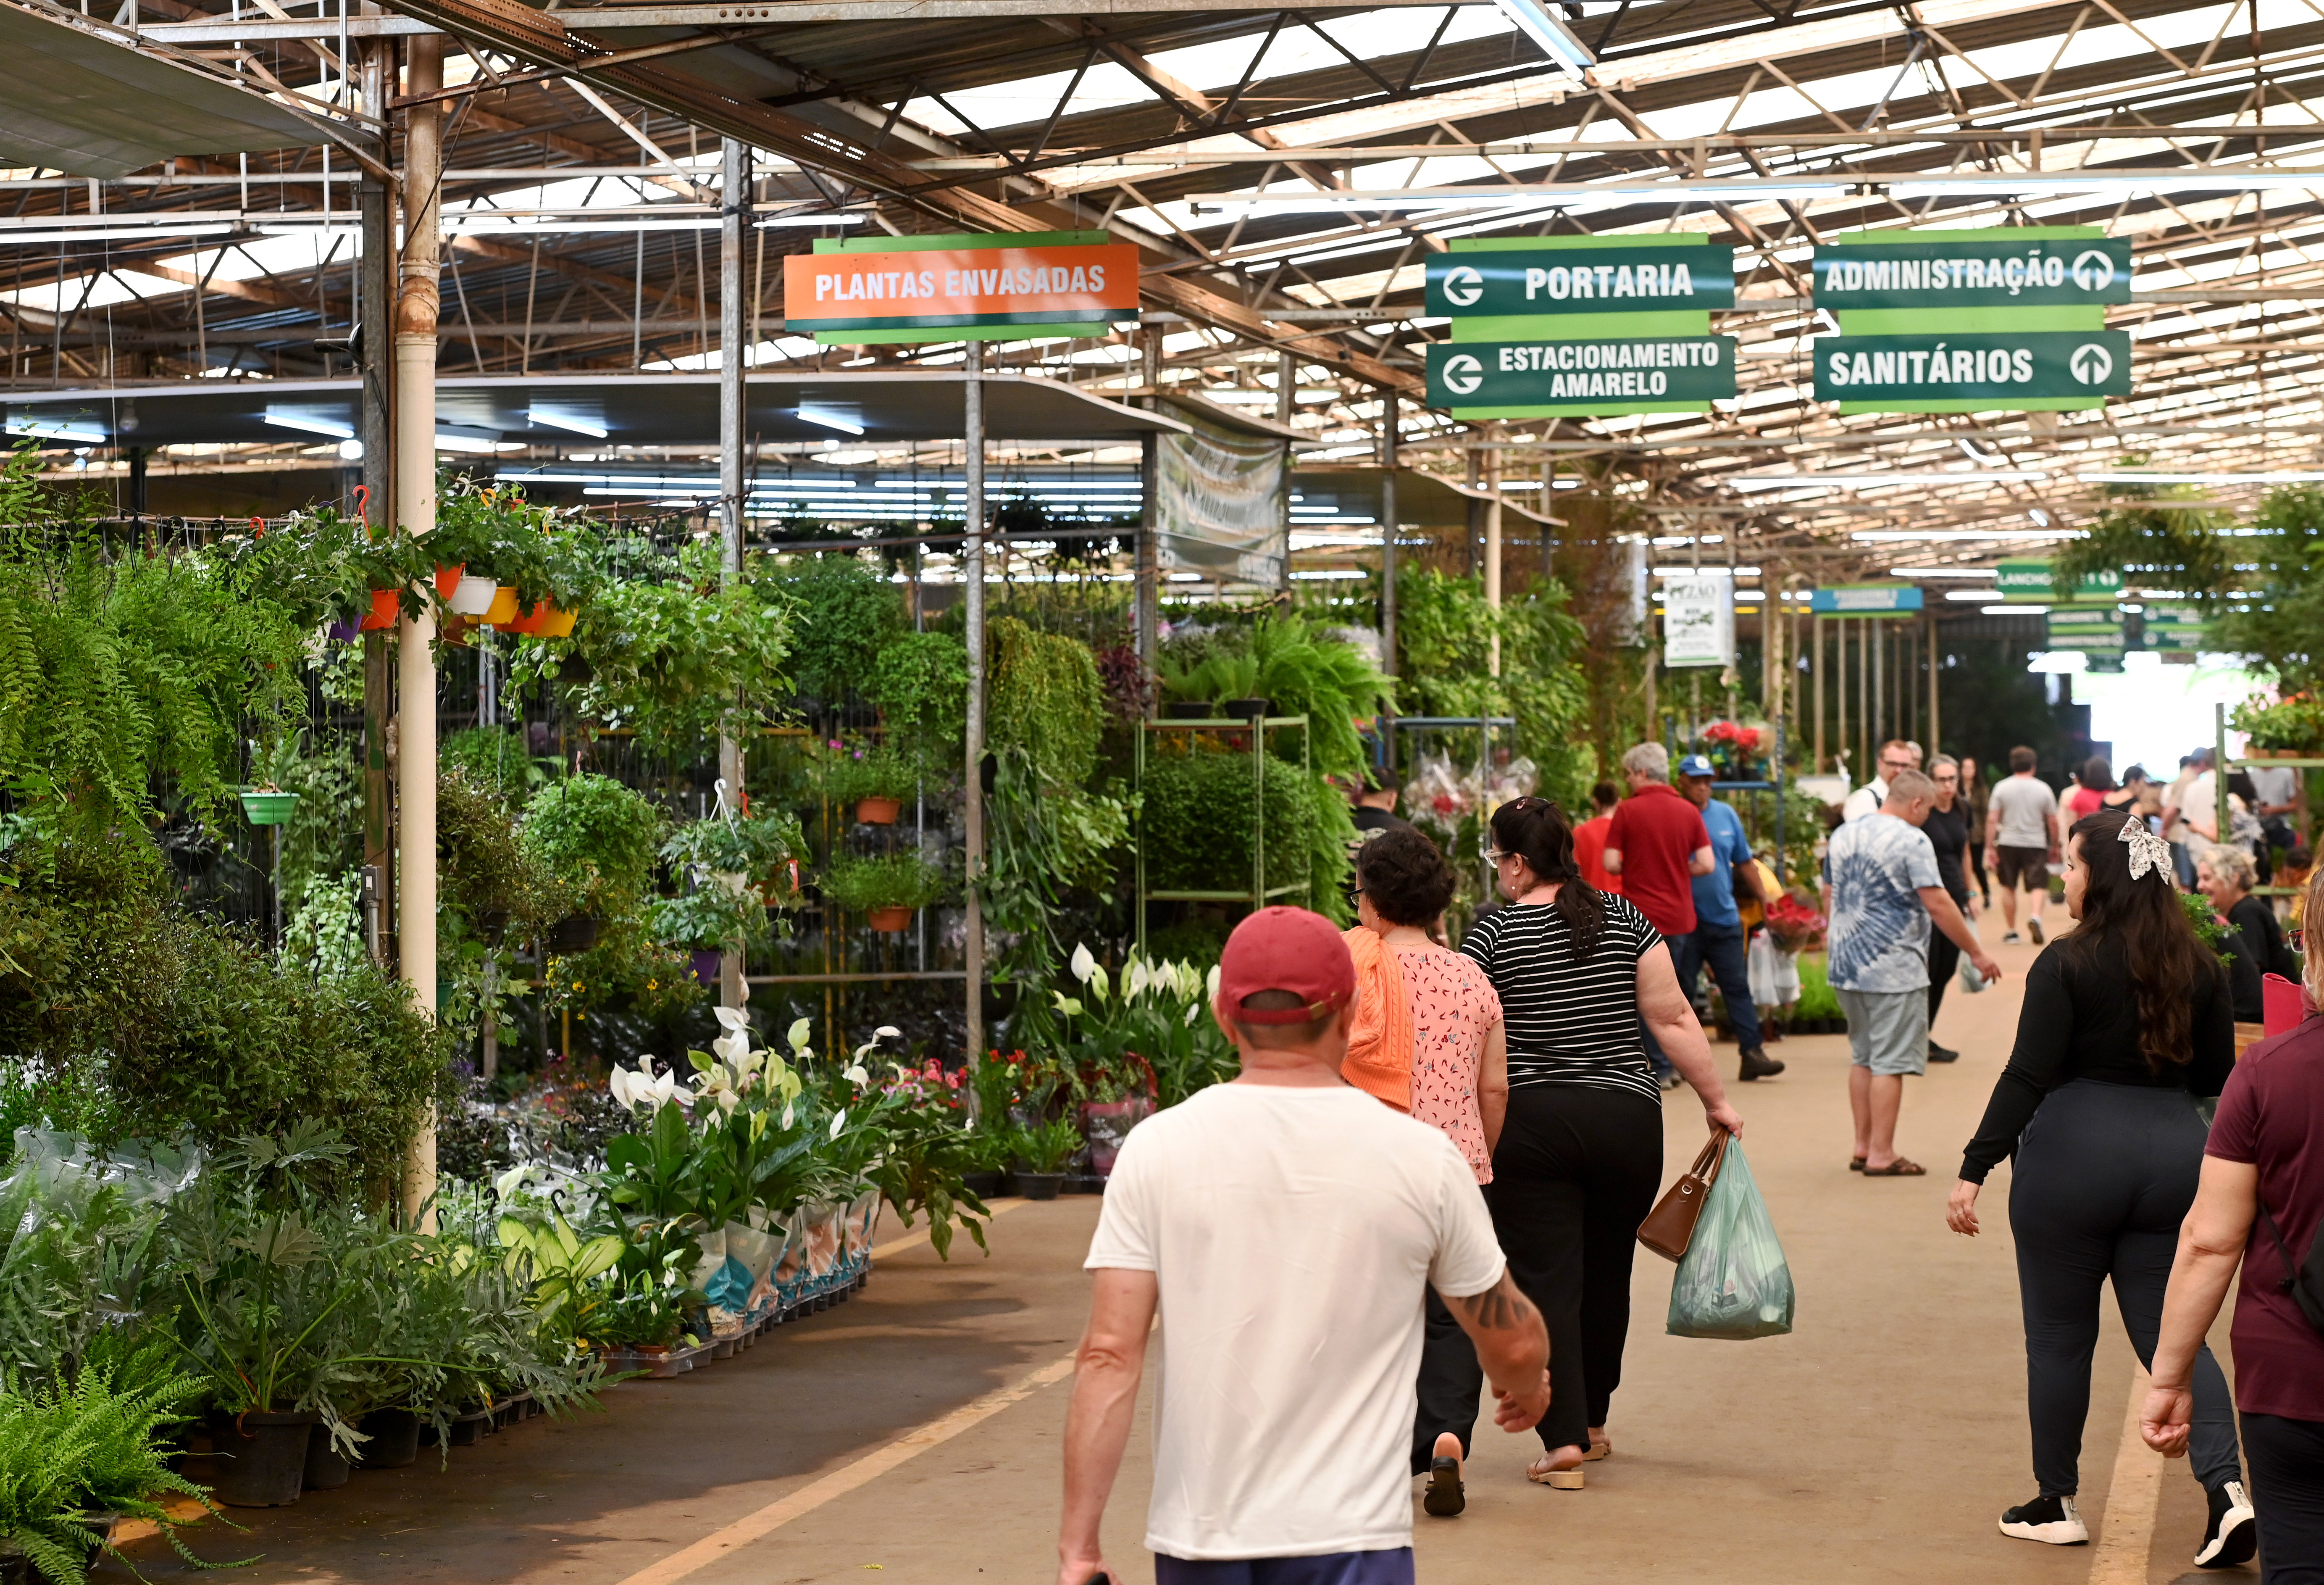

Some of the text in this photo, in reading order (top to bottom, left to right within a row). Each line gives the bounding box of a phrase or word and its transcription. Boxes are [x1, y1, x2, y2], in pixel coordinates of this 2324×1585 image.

[815, 265, 1105, 302] PLANTAS ENVASADAS
[1525, 263, 1694, 300] PORTARIA
[1824, 250, 2064, 296] ADMINISTRAÇÃO
[1499, 342, 1719, 371] ESTACIONAMENTO
[1829, 342, 2033, 385] SANITÁRIOS
[1550, 371, 1667, 397] AMARELO
